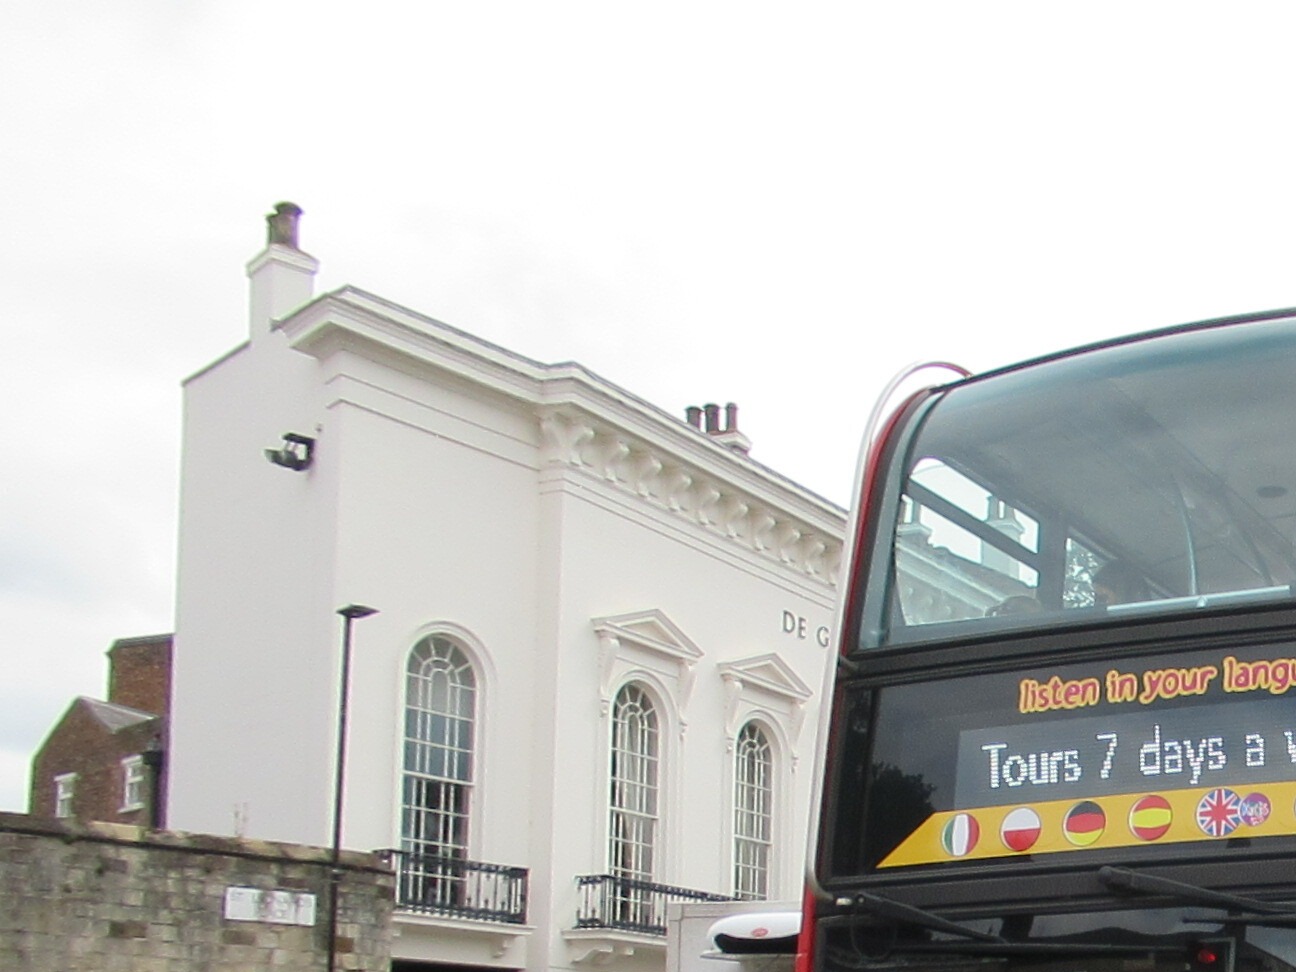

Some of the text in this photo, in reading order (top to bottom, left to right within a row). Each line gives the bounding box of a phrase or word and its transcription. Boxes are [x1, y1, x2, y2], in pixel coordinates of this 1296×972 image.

[783, 609, 807, 640] DE
[1019, 676, 1100, 714] listen
[1106, 669, 1138, 702] in
[1139, 665, 1218, 705] your
[981, 743, 1082, 789] Tours
[1096, 732, 1118, 779] 7
[1139, 723, 1227, 785] days
[1245, 733, 1266, 767] a
